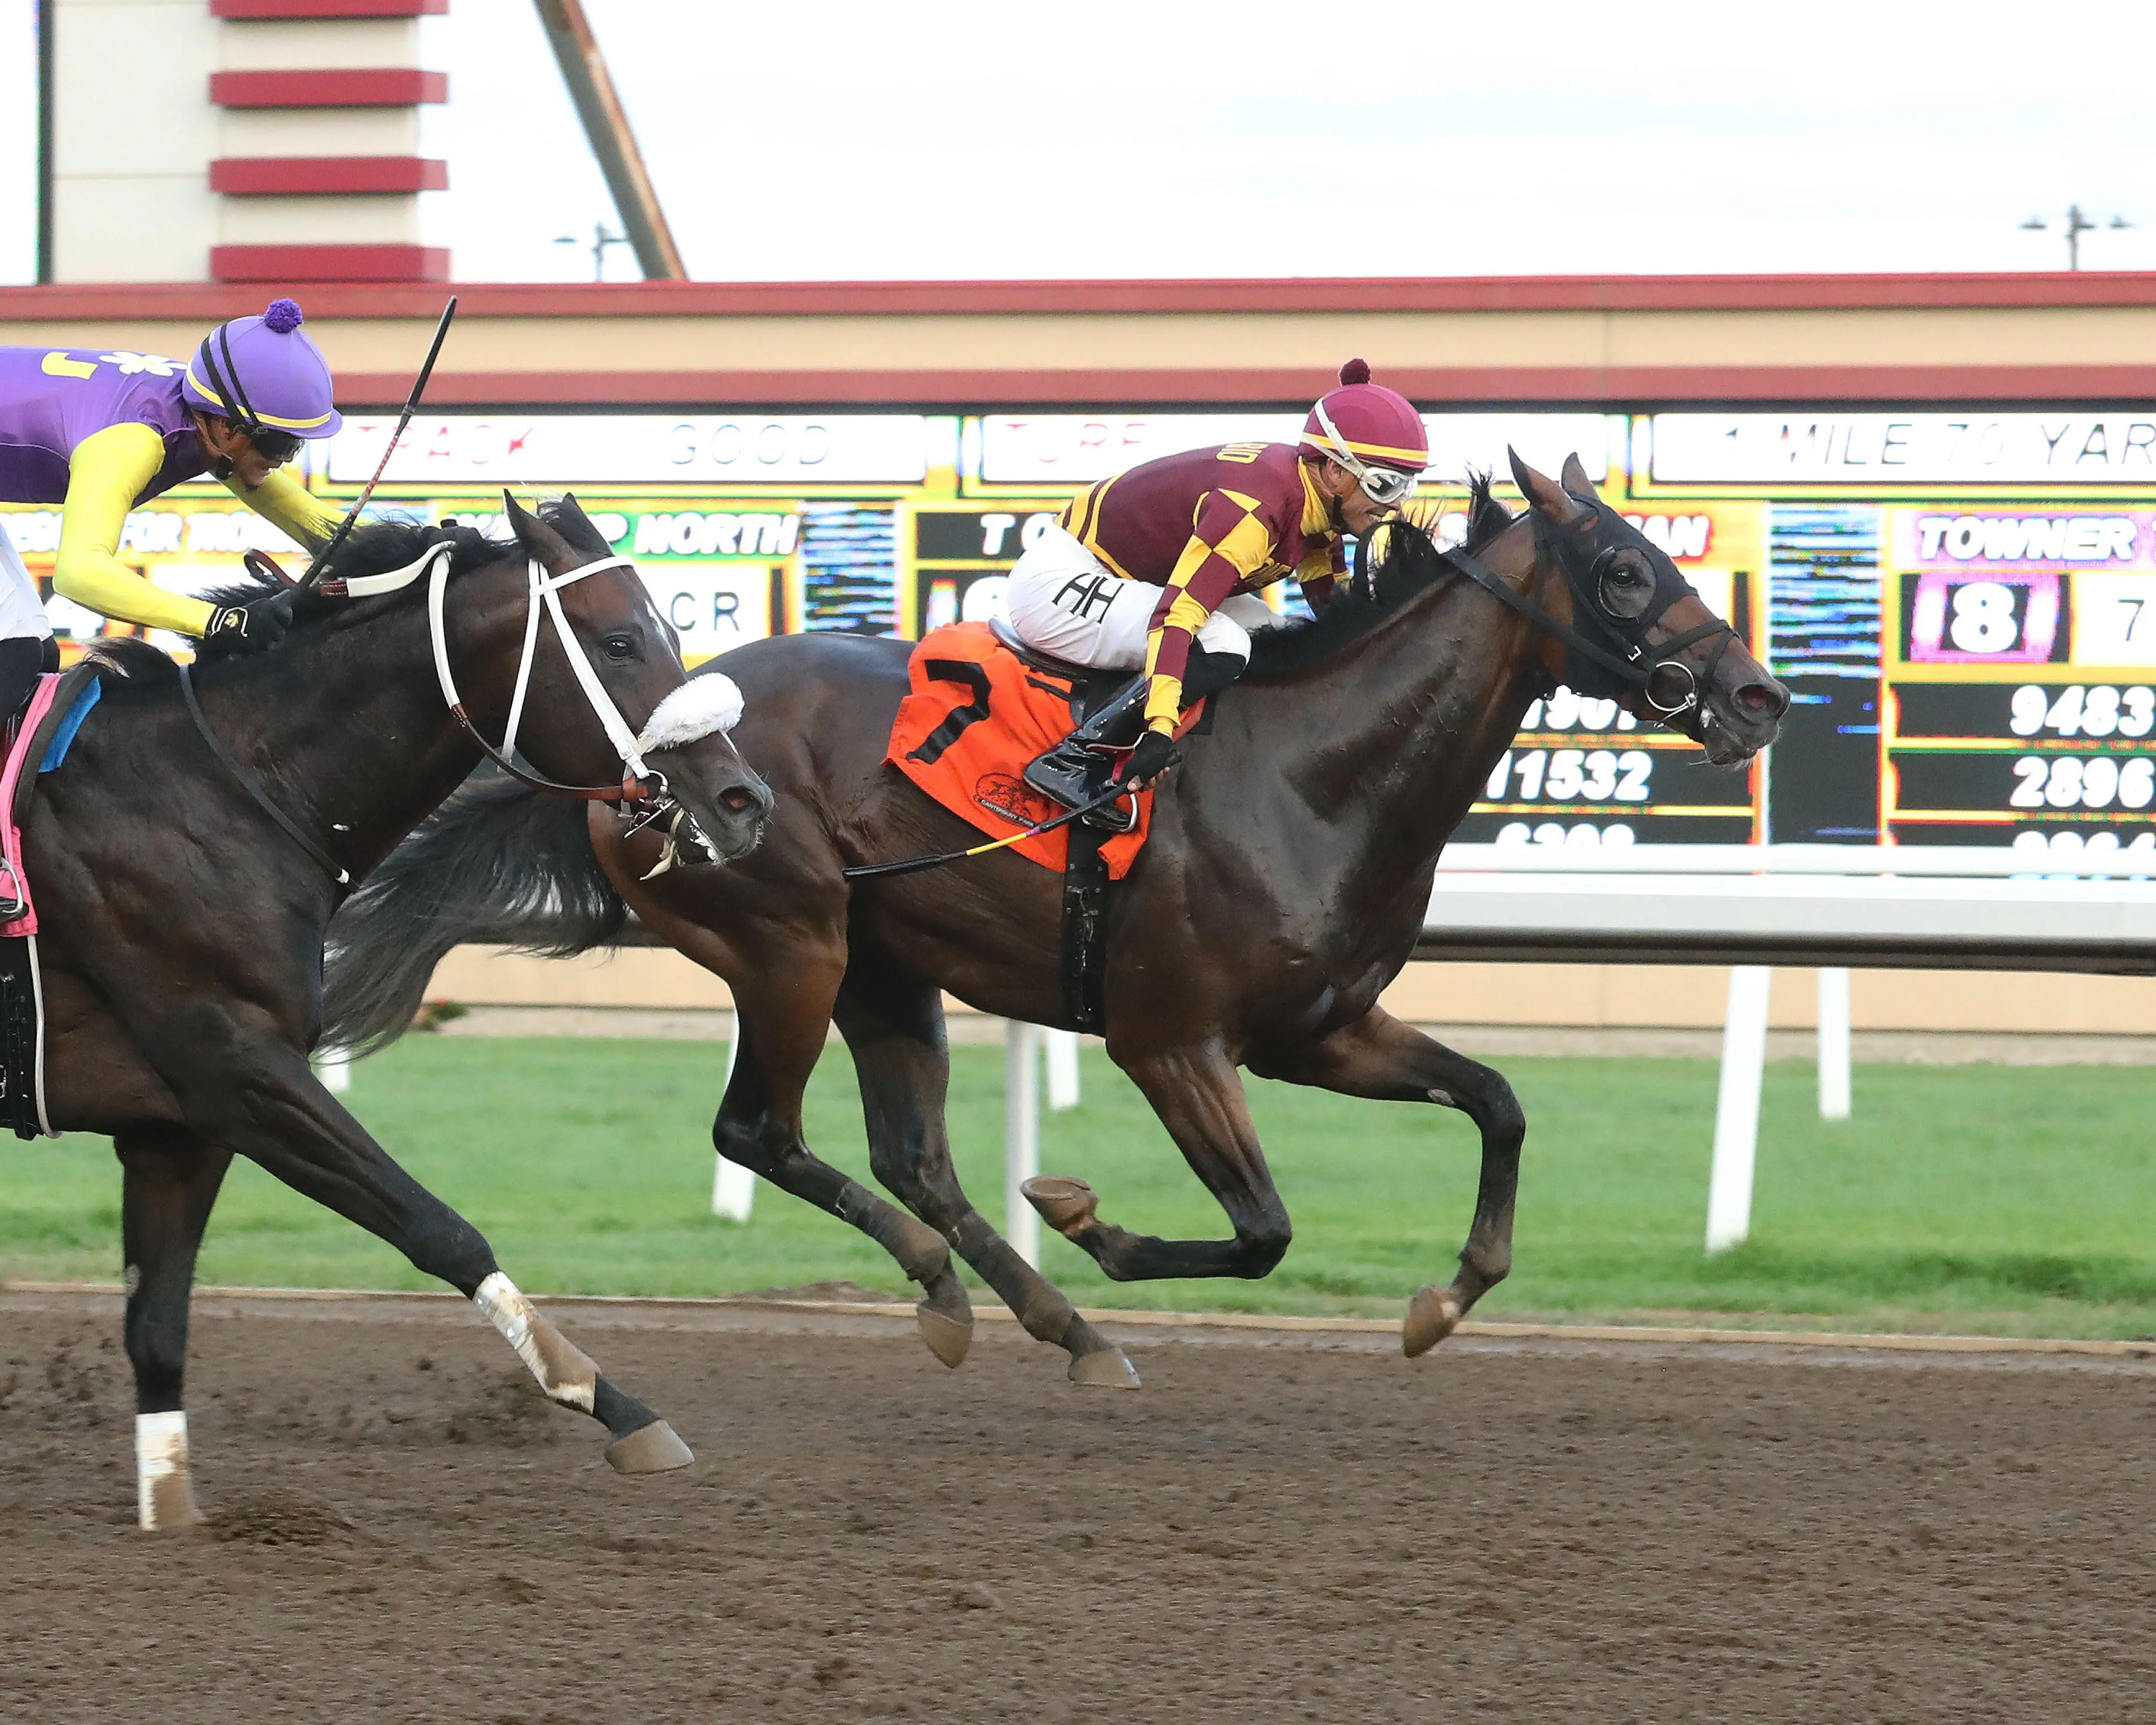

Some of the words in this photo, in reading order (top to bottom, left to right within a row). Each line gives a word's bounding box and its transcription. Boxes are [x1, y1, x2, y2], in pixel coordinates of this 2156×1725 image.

[669, 423, 829, 465] GOOD
[1779, 423, 1913, 465] MILE
[634, 513, 800, 555] NORTH
[1918, 517, 2137, 560] TOWNER
[1950, 582, 2017, 653] 8
[2118, 599, 2145, 641] 7
[906, 659, 992, 765] 7
[1486, 749, 1654, 801] 11532
